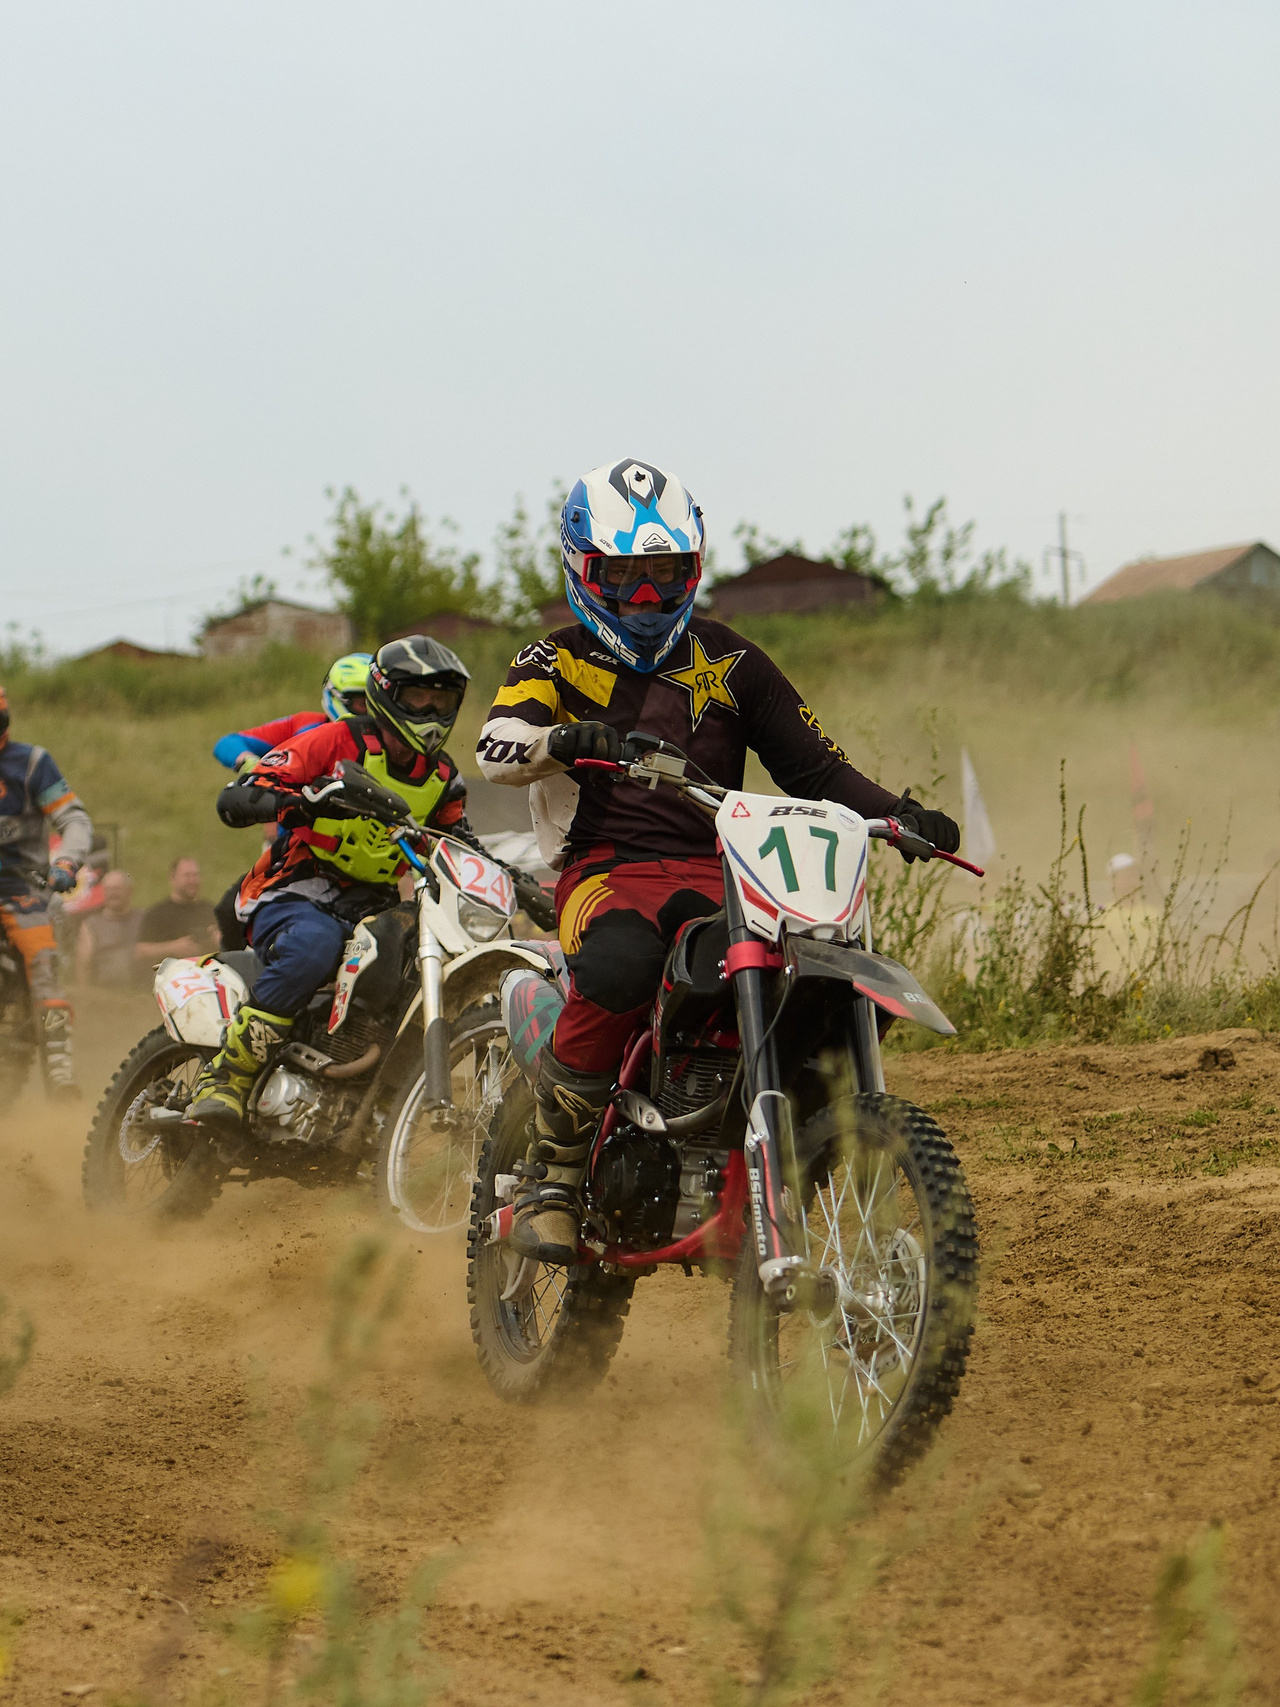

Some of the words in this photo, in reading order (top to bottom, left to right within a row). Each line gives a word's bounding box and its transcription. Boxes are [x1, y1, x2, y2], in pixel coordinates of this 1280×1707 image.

[589, 651, 621, 666] FOX
[476, 733, 540, 765] FOX
[768, 805, 829, 819] BSE
[758, 825, 840, 893] 17
[463, 856, 508, 910] 24
[748, 1167, 767, 1256] BSEmoto
